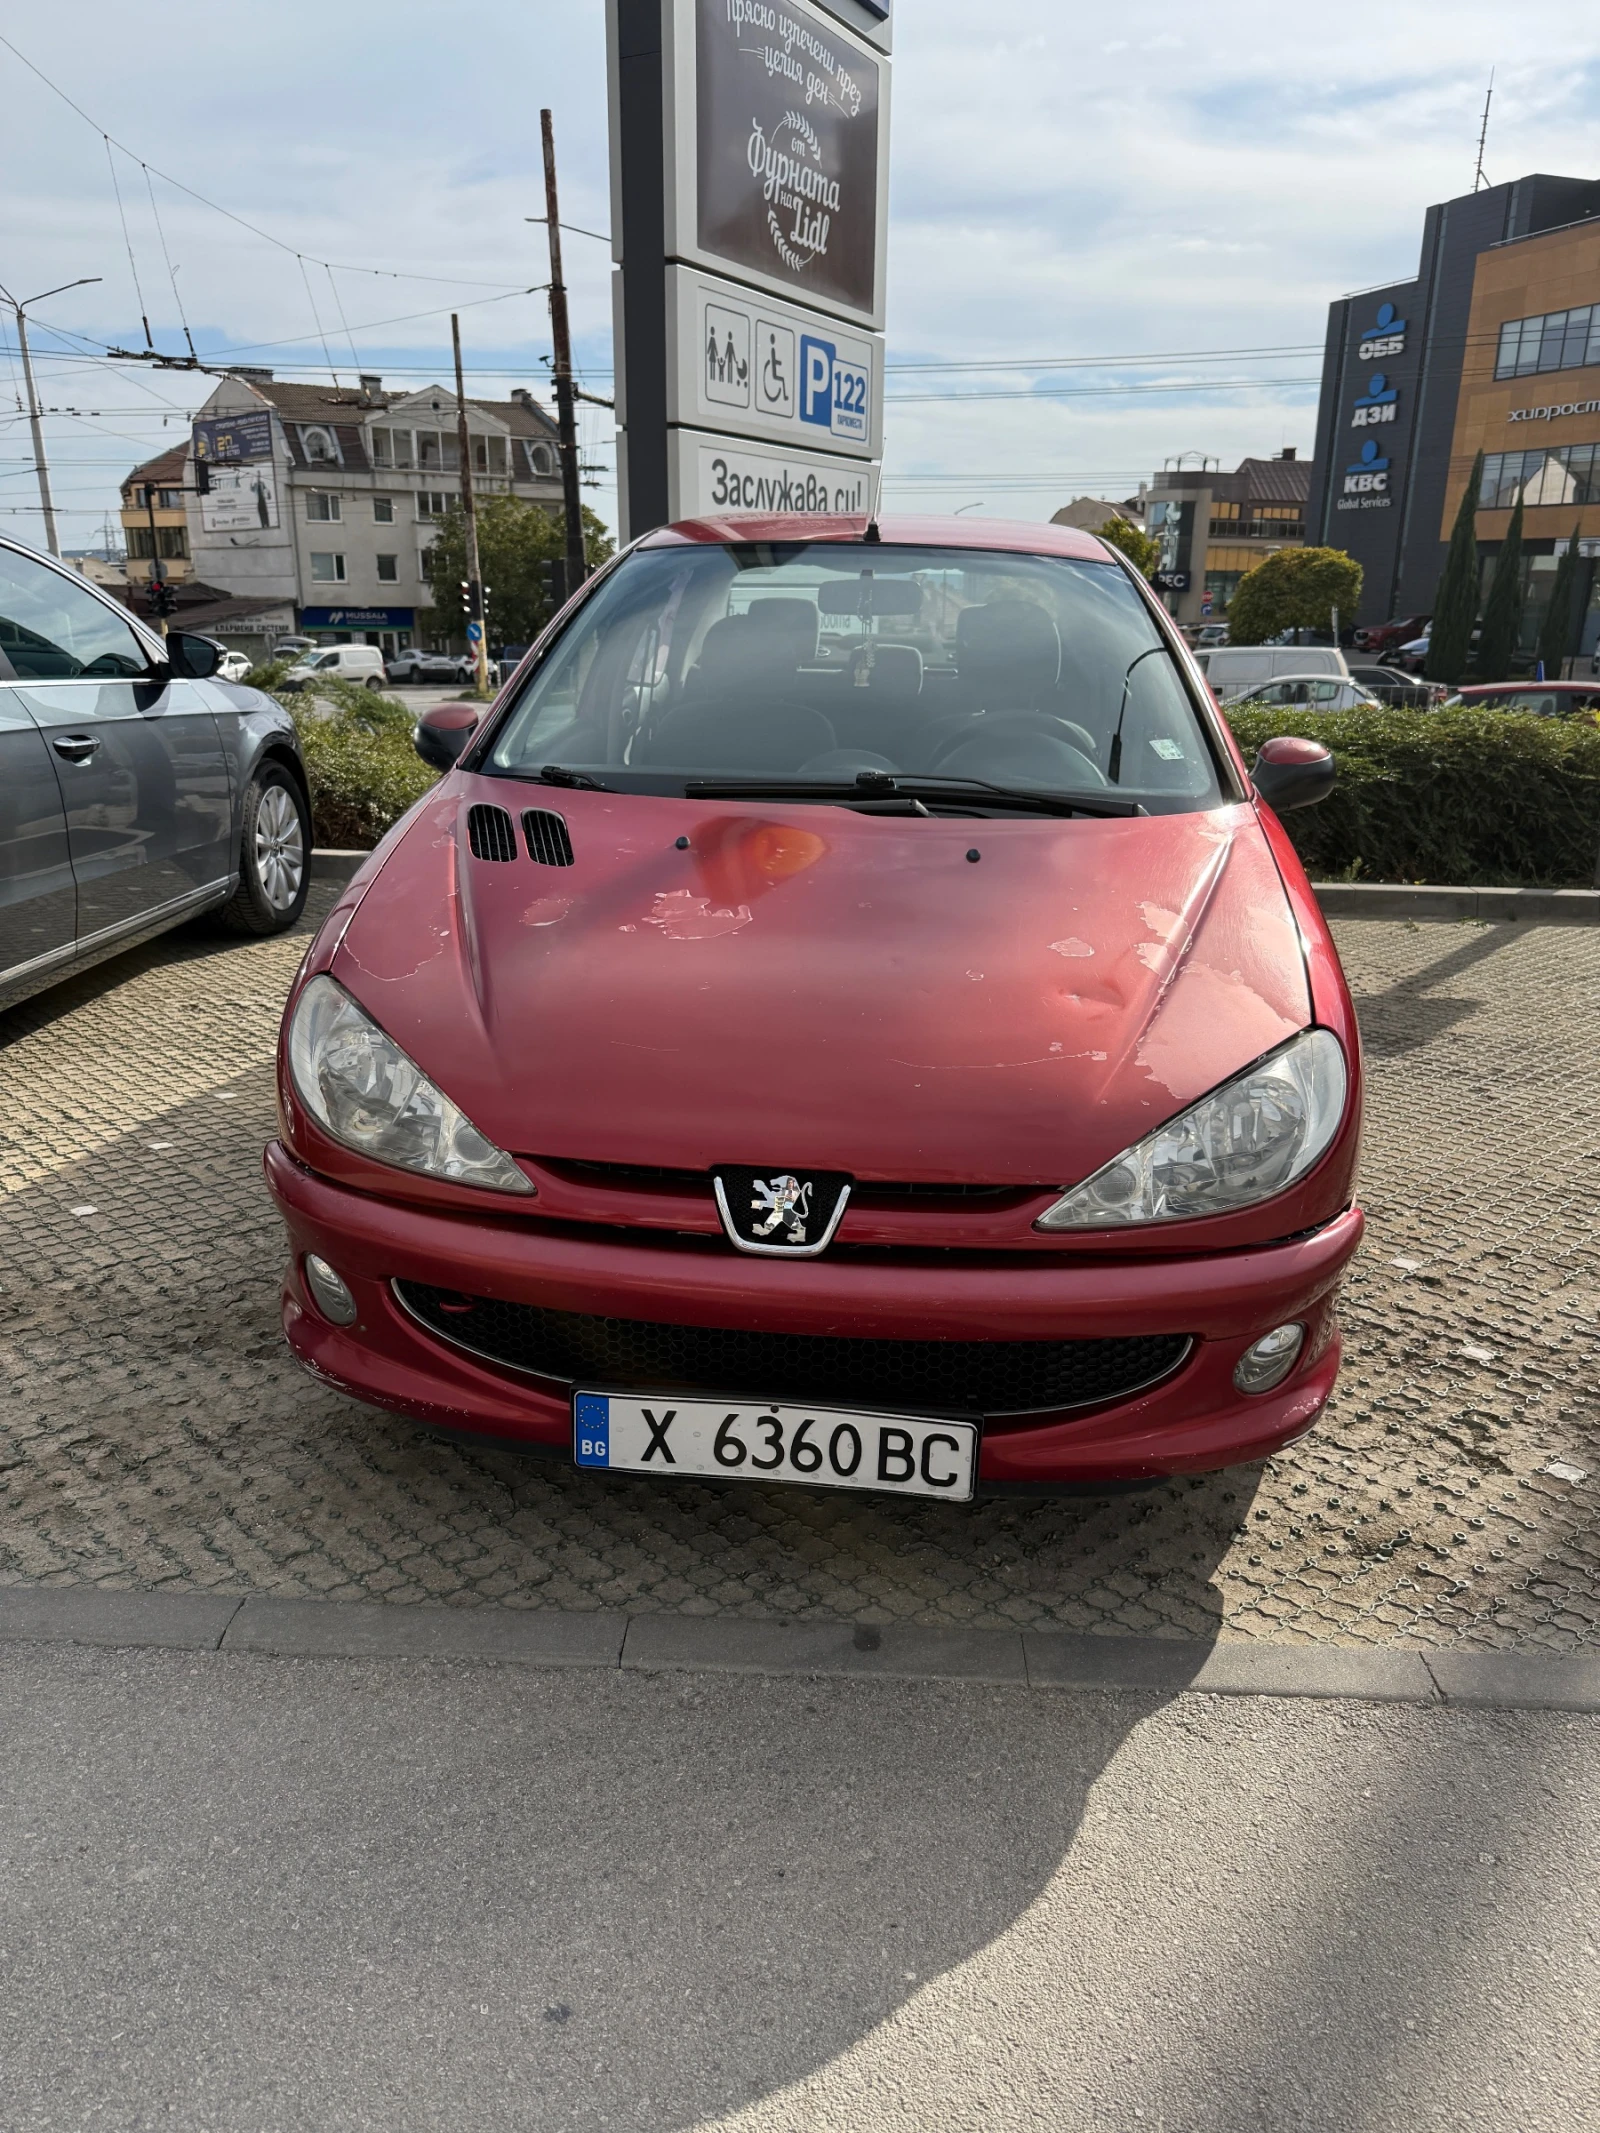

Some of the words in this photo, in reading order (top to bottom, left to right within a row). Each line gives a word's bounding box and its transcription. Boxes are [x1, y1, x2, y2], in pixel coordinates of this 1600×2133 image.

[764, 46, 803, 85] целия
[806, 71, 828, 105] ден
[779, 14, 835, 75] изпечени
[836, 64, 861, 117] през
[747, 117, 840, 212] Фурната
[791, 137, 805, 157] от
[780, 190, 792, 210] на
[790, 196, 830, 255] Lidl
[1359, 334, 1404, 360] ОББ
[806, 344, 830, 416] P
[834, 371, 865, 415] 122
[1351, 404, 1396, 428] ДЗИ
[711, 458, 828, 512] Заслужава
[1344, 473, 1387, 493] KBC
[1337, 498, 1359, 510] Global
[1360, 496, 1391, 509] Services
[345, 611, 388, 620] MUSSALA
[582, 1439, 606, 1456] BG
[641, 1408, 677, 1464] X
[713, 1413, 862, 1477] 6360
[877, 1426, 960, 1487] BC
